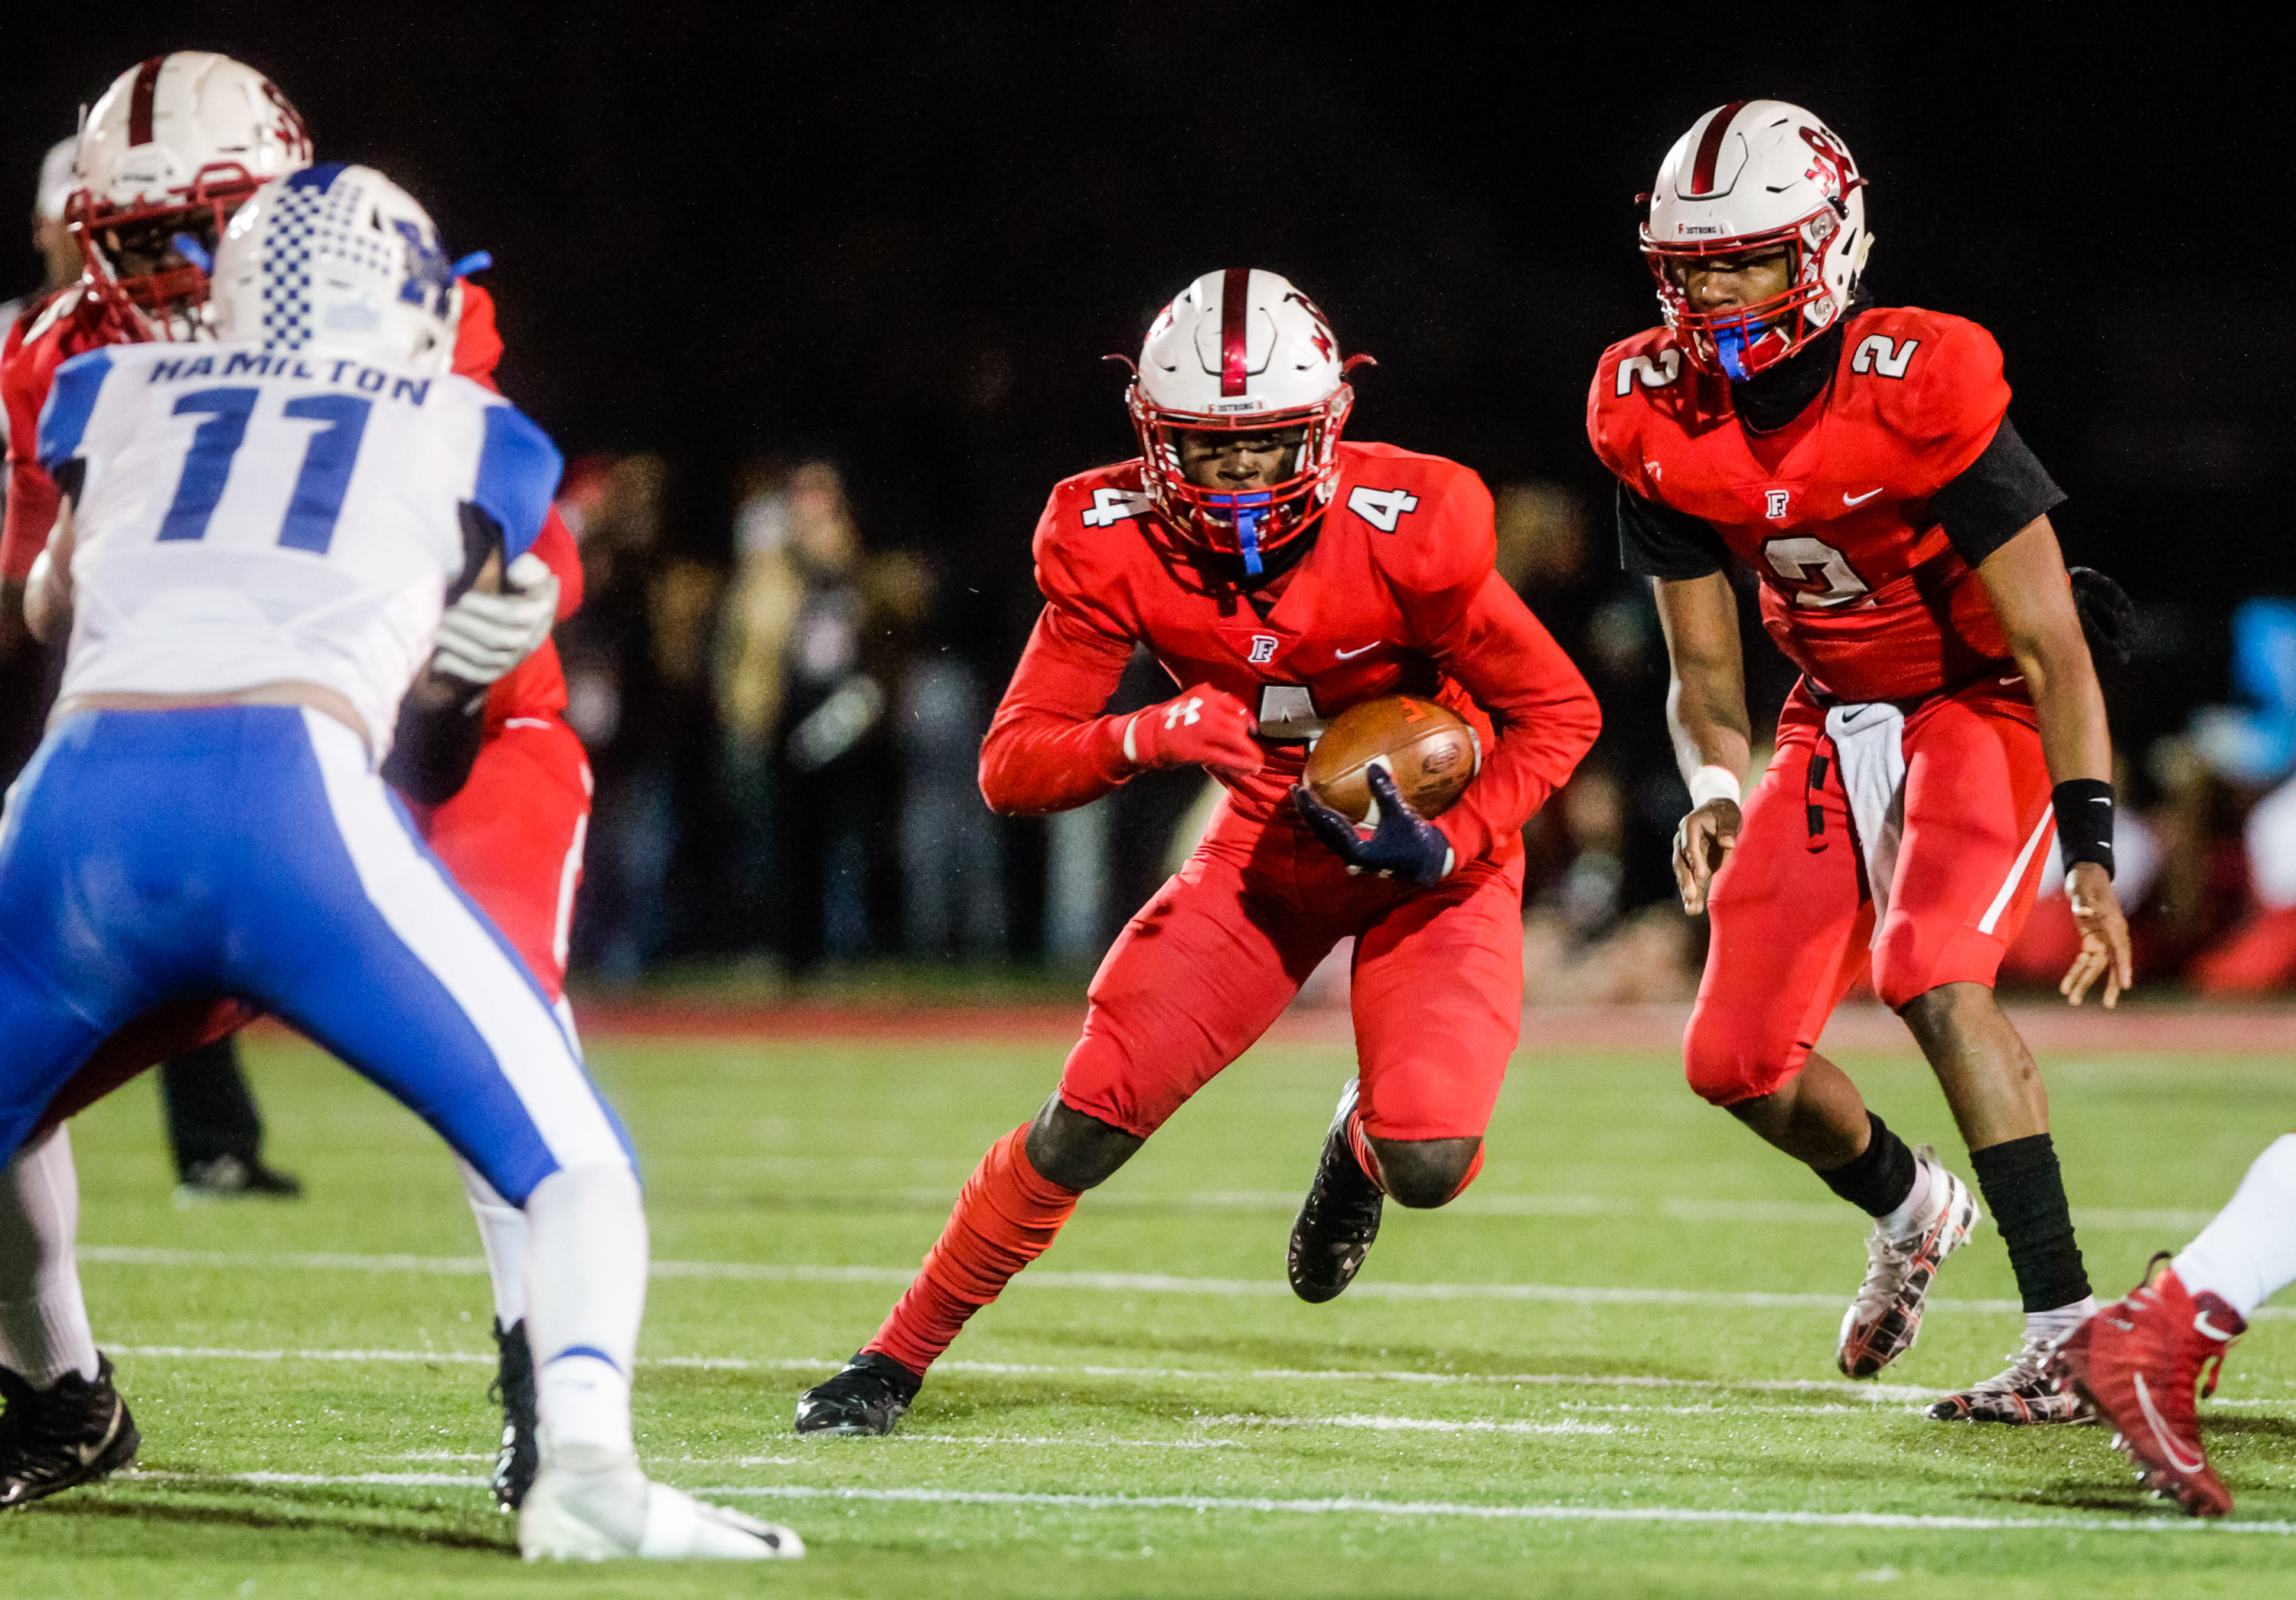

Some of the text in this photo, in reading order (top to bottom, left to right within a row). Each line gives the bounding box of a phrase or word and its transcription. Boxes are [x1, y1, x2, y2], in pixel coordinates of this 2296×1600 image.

[150, 352, 432, 407] HAMILTON
[1616, 348, 1681, 397] 2
[1852, 335, 1920, 380] 2
[155, 387, 373, 556] 11
[1081, 488, 1152, 529] 4
[1347, 486, 1420, 534] 4
[1765, 490, 1789, 519] F
[1247, 635, 1278, 664] F
